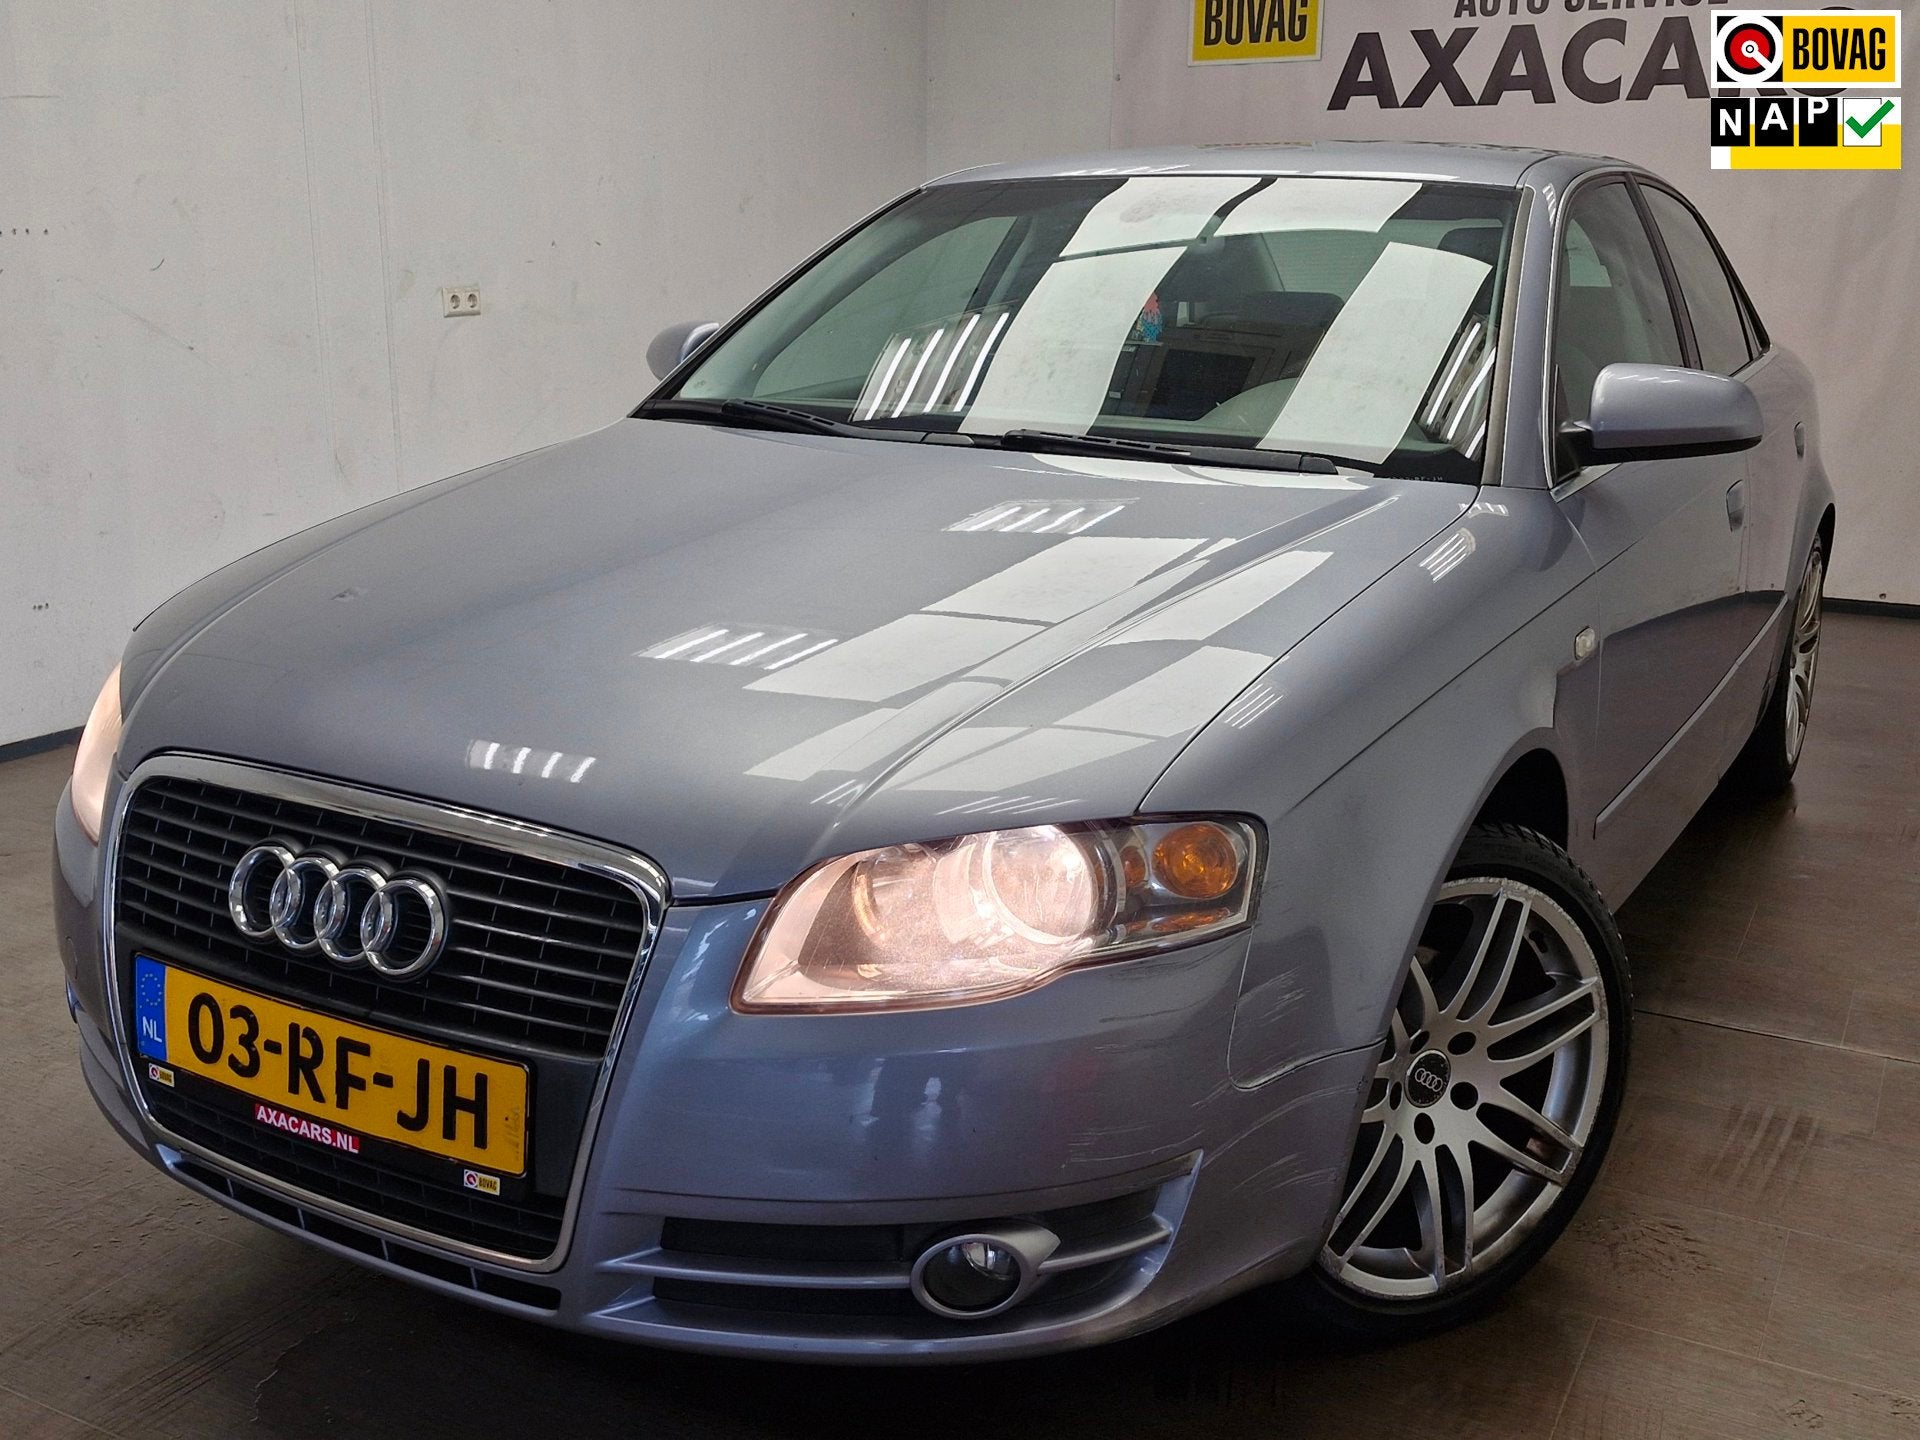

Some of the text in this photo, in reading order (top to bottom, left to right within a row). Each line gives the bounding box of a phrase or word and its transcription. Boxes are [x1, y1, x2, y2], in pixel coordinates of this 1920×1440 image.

[1203, 0, 1309, 46] BOVAG
[1326, 7, 1857, 111] AXACA
[142, 1016, 163, 1043] NL
[187, 992, 489, 1150] 03-RF-JH
[256, 1105, 360, 1154] AXACARS.NL
